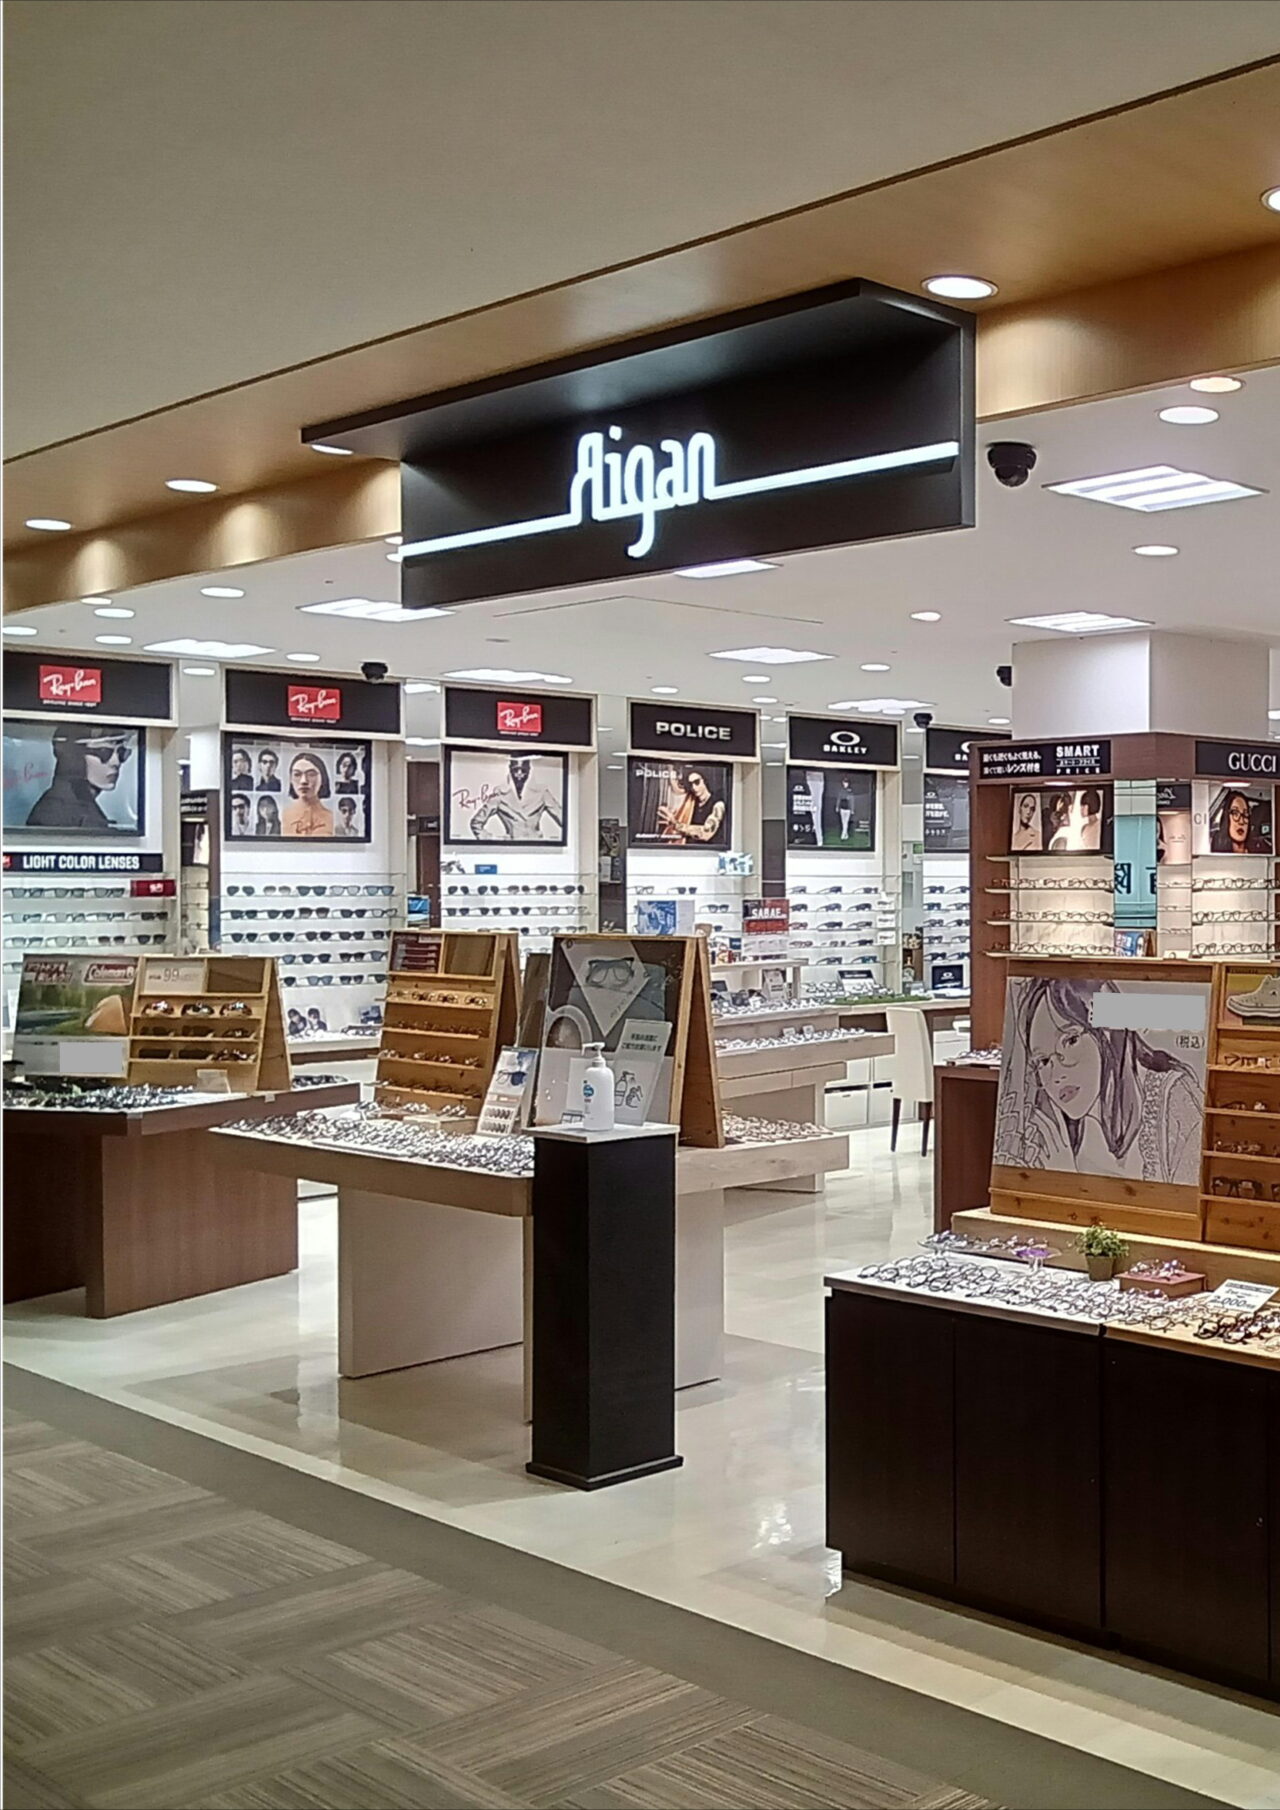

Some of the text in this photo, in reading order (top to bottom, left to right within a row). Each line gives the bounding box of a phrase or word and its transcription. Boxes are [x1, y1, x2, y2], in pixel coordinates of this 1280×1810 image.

[570, 425, 717, 559] Aigan
[655, 721, 731, 740] POLICE
[823, 744, 867, 754] OAKLEY
[1056, 744, 1100, 757] SMART
[1228, 752, 1277, 773] GUCCI
[635, 769, 678, 780] POLICE
[23, 855, 139, 869] LIGHT COLOR LENSES
[751, 908, 781, 919] SABAE
[1175, 1035, 1206, 1049] (税込)
